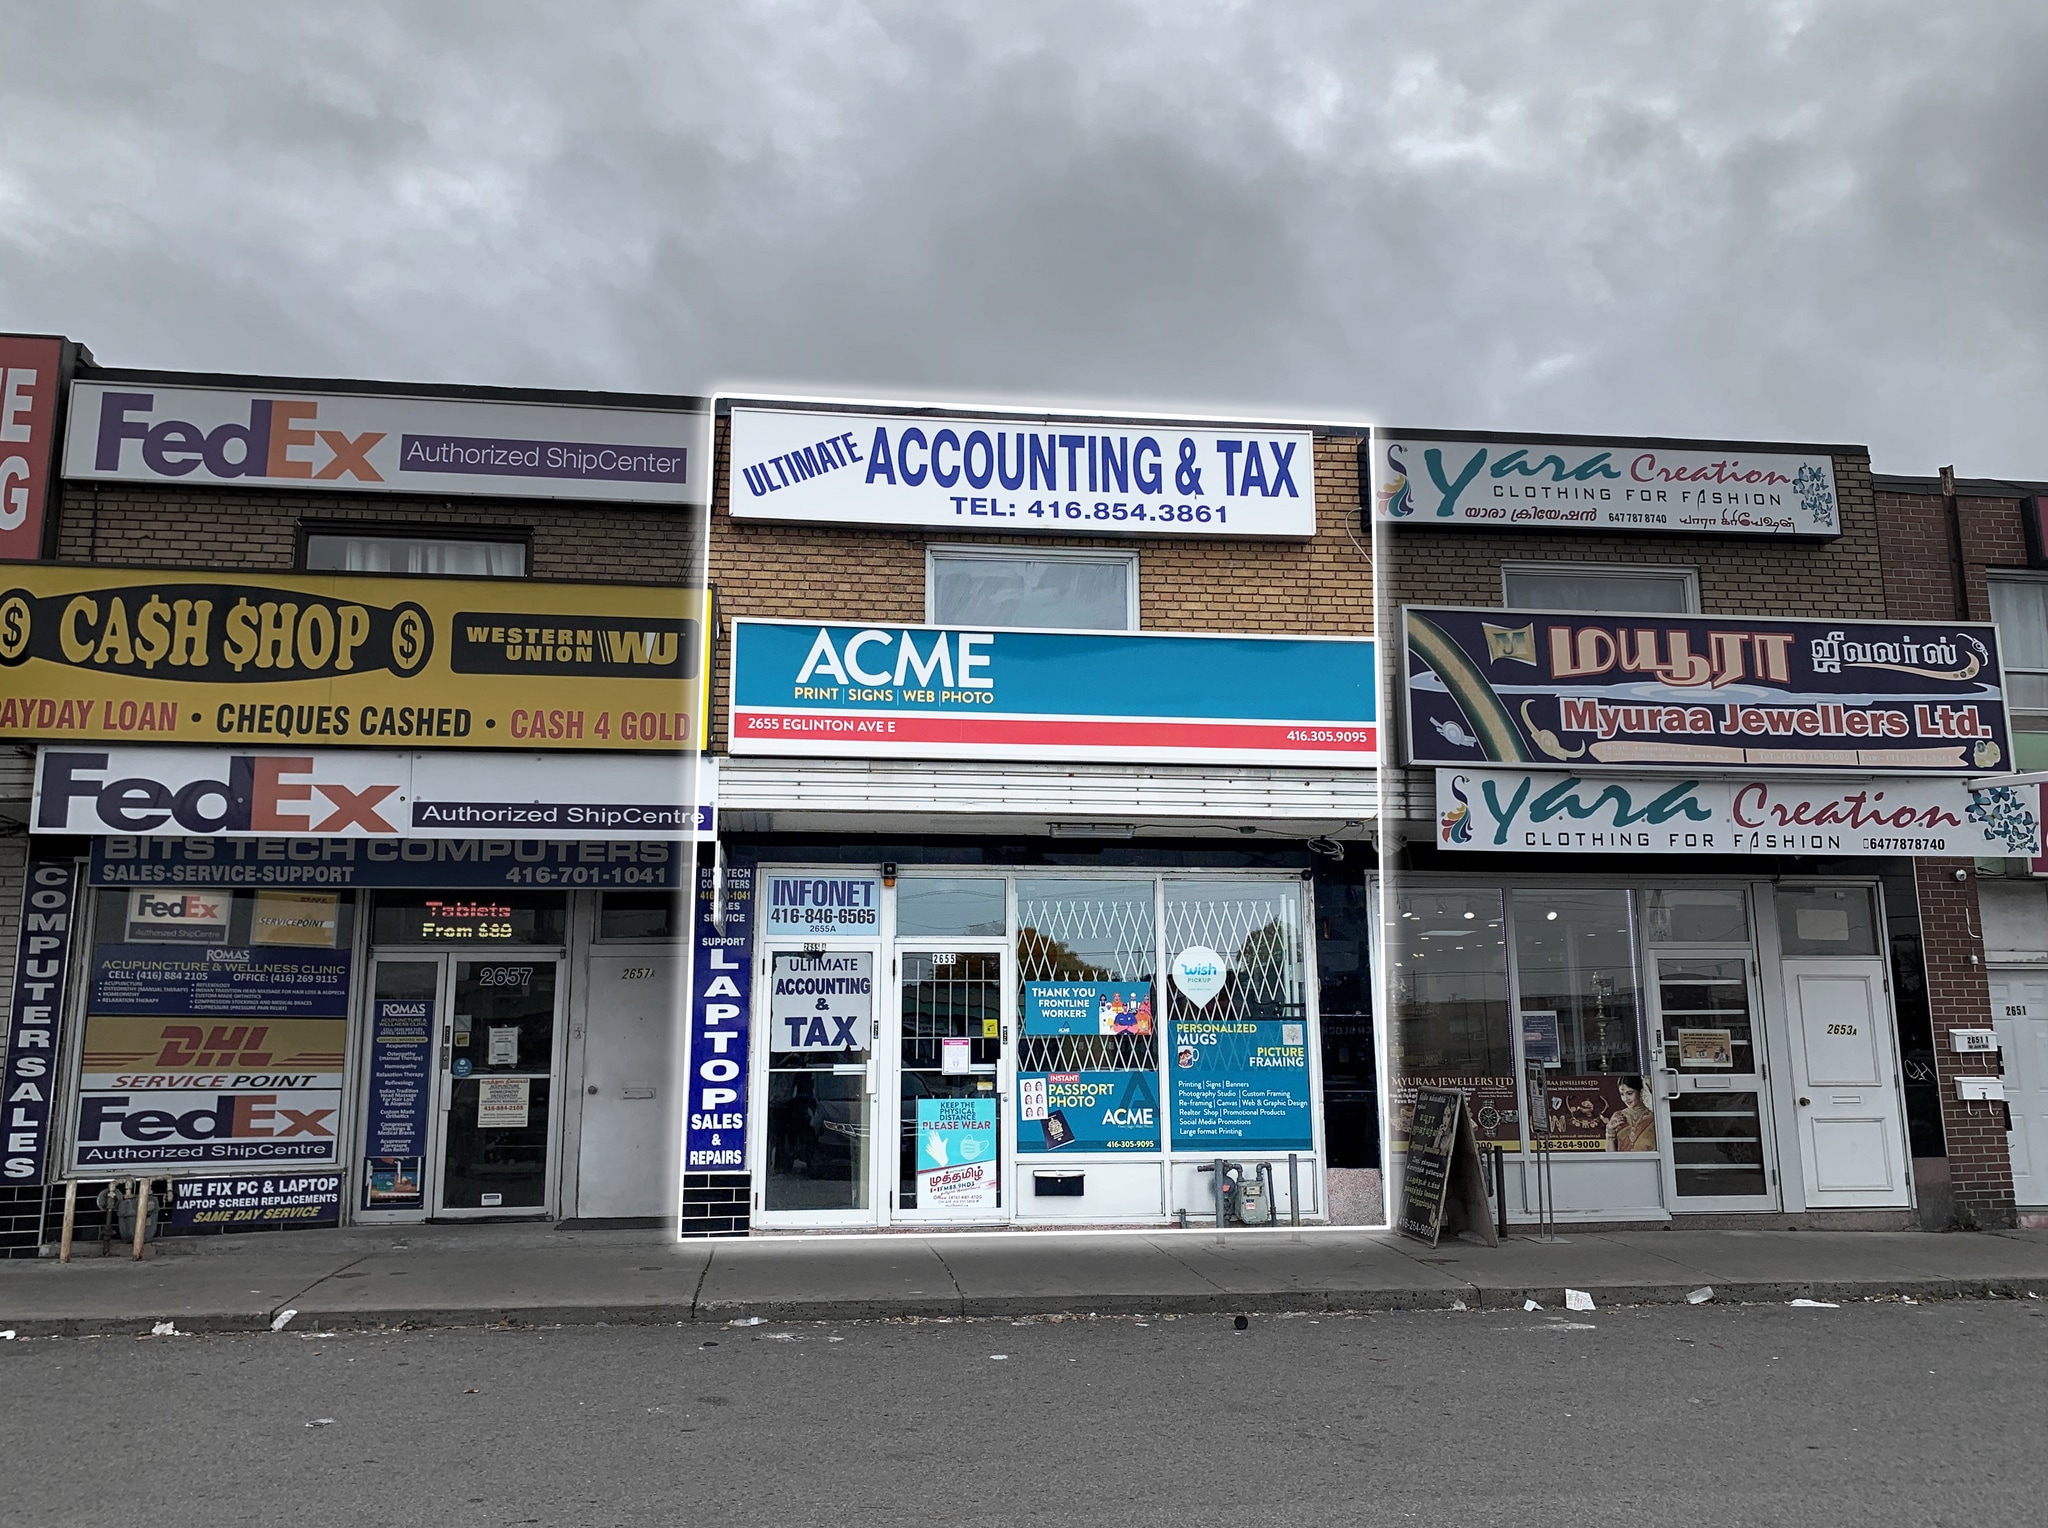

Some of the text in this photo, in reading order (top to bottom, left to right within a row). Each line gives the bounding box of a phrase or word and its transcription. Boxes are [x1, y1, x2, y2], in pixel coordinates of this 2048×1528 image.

[95, 391, 388, 482] FedEx
[407, 441, 680, 473] Authorized ShipCenter
[742, 431, 864, 496] ULTIMATE
[865, 427, 1299, 497] ACCOUNTING & TAX
[1424, 447, 1791, 517] Yara Creation
[1494, 485, 1782, 509] CLOTHING FOR FASHION
[950, 497, 1227, 523] TEL: 416.854.3861
[466, 625, 592, 645] WESTERN
[506, 644, 593, 663] UNION
[606, 630, 679, 665] WU
[795, 627, 994, 688] ACME
[794, 687, 994, 704] PRINT SIGNS WEB PHOTO
[103, 701, 691, 741] LOAN CHEQUES CASHED CASH 4 GOLD
[748, 717, 896, 733] 2655 EGLINTON AVE E
[1560, 697, 1992, 739] Myuraa Jewellers Ltd.
[1286, 730, 1367, 743] 416.305.9095
[37, 752, 400, 833] FedEx
[422, 805, 705, 827] Authorized ShipCentre
[1482, 777, 1961, 844] Yara Creation
[104, 836, 670, 862] BITS TECH COMPUTERS
[1526, 832, 1945, 850] CLOTHING FOR FASHION 6477878740
[103, 865, 666, 883] SALES-SERVICE-SUPPORT 416-701-1041
[772, 880, 875, 907] INFONET
[137, 894, 219, 919] FedEx
[770, 908, 876, 924] 416-846-6565
[422, 922, 473, 938] From
[809, 925, 837, 933] 2655A
[702, 937, 746, 946] SUPPORT
[789, 958, 858, 972] ULTIMATE
[933, 954, 956, 964] 2655
[101, 960, 346, 975] ACUPUNCTURE WELLNESS CLINIC
[1181, 963, 1217, 976] wish
[108, 971, 338, 984] CELL: (416) 884 2105 OFFICE: (416) 269 9115
[479, 967, 533, 986] 2657
[775, 977, 871, 995] ACCOUNTING
[1031, 987, 1096, 998] THANK YOU
[382, 1003, 426, 1016] ROMA'S
[815, 998, 830, 1011] &
[1038, 999, 1090, 1008] FRONTLINE
[2005, 1005, 2027, 1016] 2651
[1041, 1009, 1087, 1018] WORKERS
[700, 949, 742, 1110] LAPTOP
[784, 1016, 858, 1047] TAX
[1176, 1023, 1258, 1034] PERSONALIZED
[1827, 1023, 1858, 1037] 2653A
[155, 1025, 273, 1067] DHL
[1176, 1034, 1217, 1045] MUGS
[1257, 1047, 1304, 1057] PICTURE
[1249, 1056, 1304, 1067] FRAMING
[112, 1075, 317, 1088] SERVICE POINT
[1050, 1074, 1079, 1082] INSTANT
[1178, 1080, 1250, 1089] Printing Signs Banners
[1391, 1077, 1514, 1088] MYURAA JEWELLERS LTD
[1048, 1083, 1114, 1096] PASSPORT
[1178, 1090, 1216, 1098] Photography
[1266, 1090, 1291, 1099] Framing
[940, 1101, 975, 1109] KEEP THE
[1048, 1096, 1096, 1108] PHOTO
[1179, 1099, 1213, 1108] Re-framing
[1263, 1100, 1286, 1108] Graphic
[1287, 1099, 1308, 1108] Design
[77, 1094, 337, 1142] FedEx
[1102, 1109, 1153, 1126] ACME
[1203, 1109, 1219, 1117] Shop
[691, 1113, 742, 1130] SALES
[922, 1121, 991, 1130] PLEASE WEAR
[1179, 1118, 1252, 1126] Social Media Promotions
[1179, 1127, 1243, 1137] Large format Printing
[86, 1143, 326, 1160] Authorized ShipCentre
[1106, 1140, 1155, 1148] 416-305-9095
[690, 1150, 742, 1165] REPAIRS
[178, 1177, 339, 1198] WE FIX PC LAPTOP
[176, 1194, 338, 1209] LAPTOP SCREEN REPLACEMENTS
[193, 1206, 321, 1223] SAME DAY SERVICE
